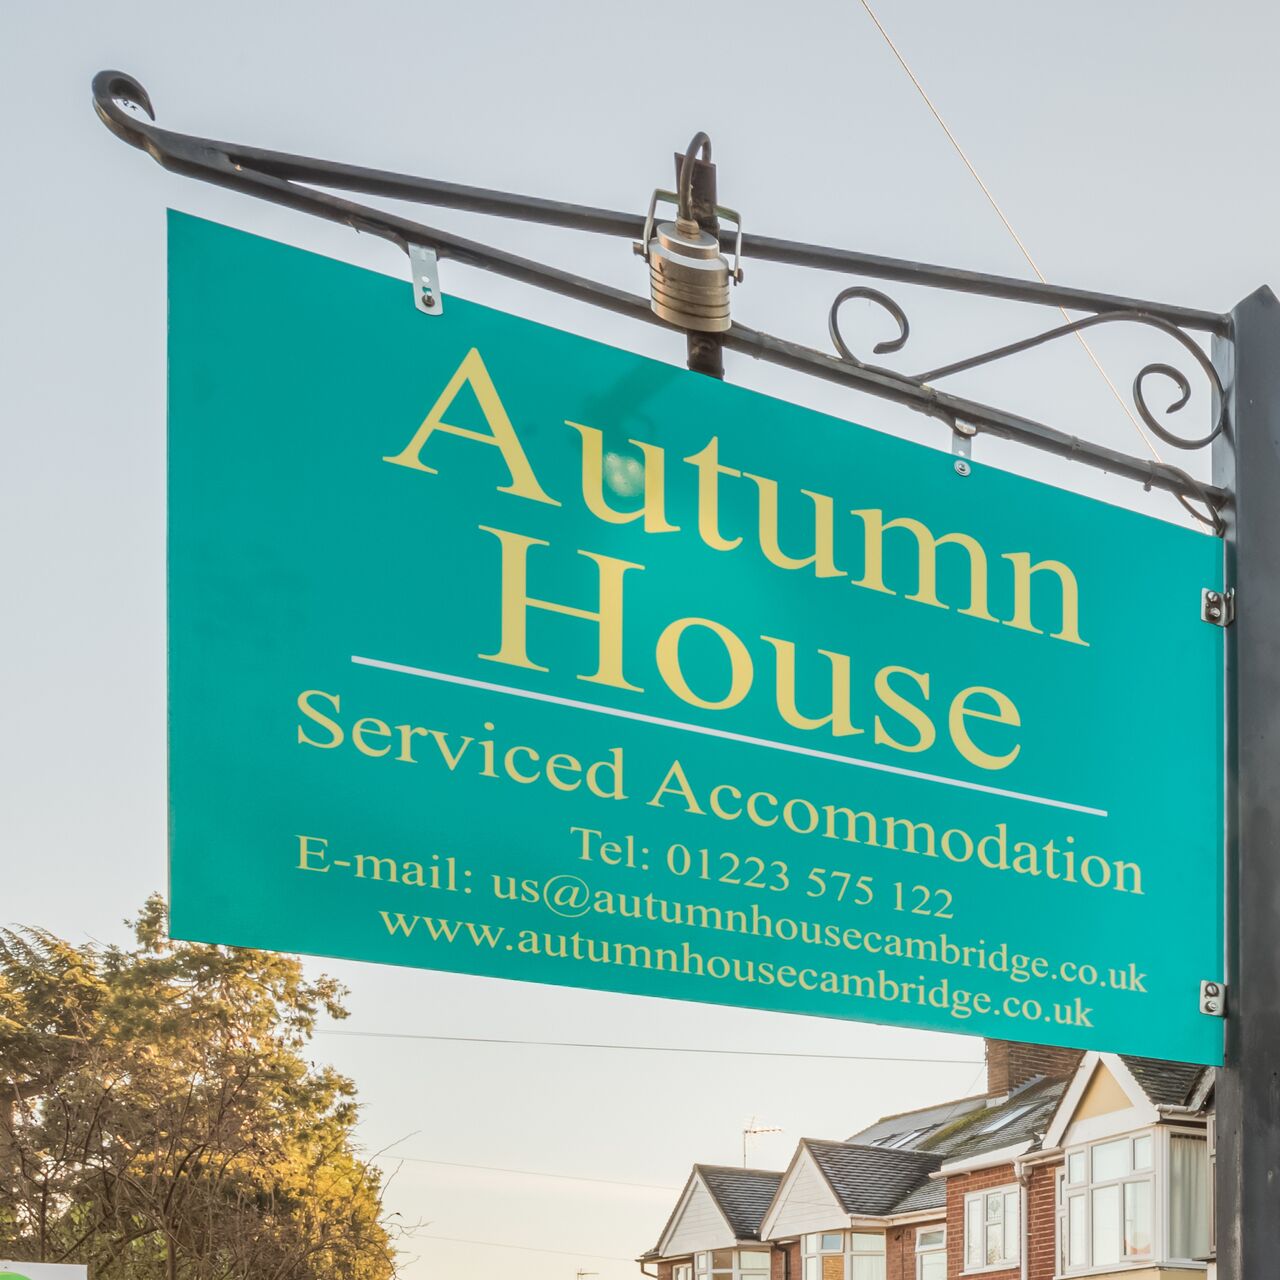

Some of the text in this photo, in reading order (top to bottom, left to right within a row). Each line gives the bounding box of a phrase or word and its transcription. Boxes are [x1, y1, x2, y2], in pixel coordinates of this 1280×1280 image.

[382, 346, 1091, 647] Autumn
[478, 525, 1021, 771] House
[296, 689, 1144, 895] Serviced Accommodation
[570, 826, 954, 919] Tel: 01223 575 122
[295, 834, 1147, 993] E-mail: us@autumnhousecambridge.co.uk
[379, 911, 1093, 1028] www.autumnhousecambridge.co.uk
